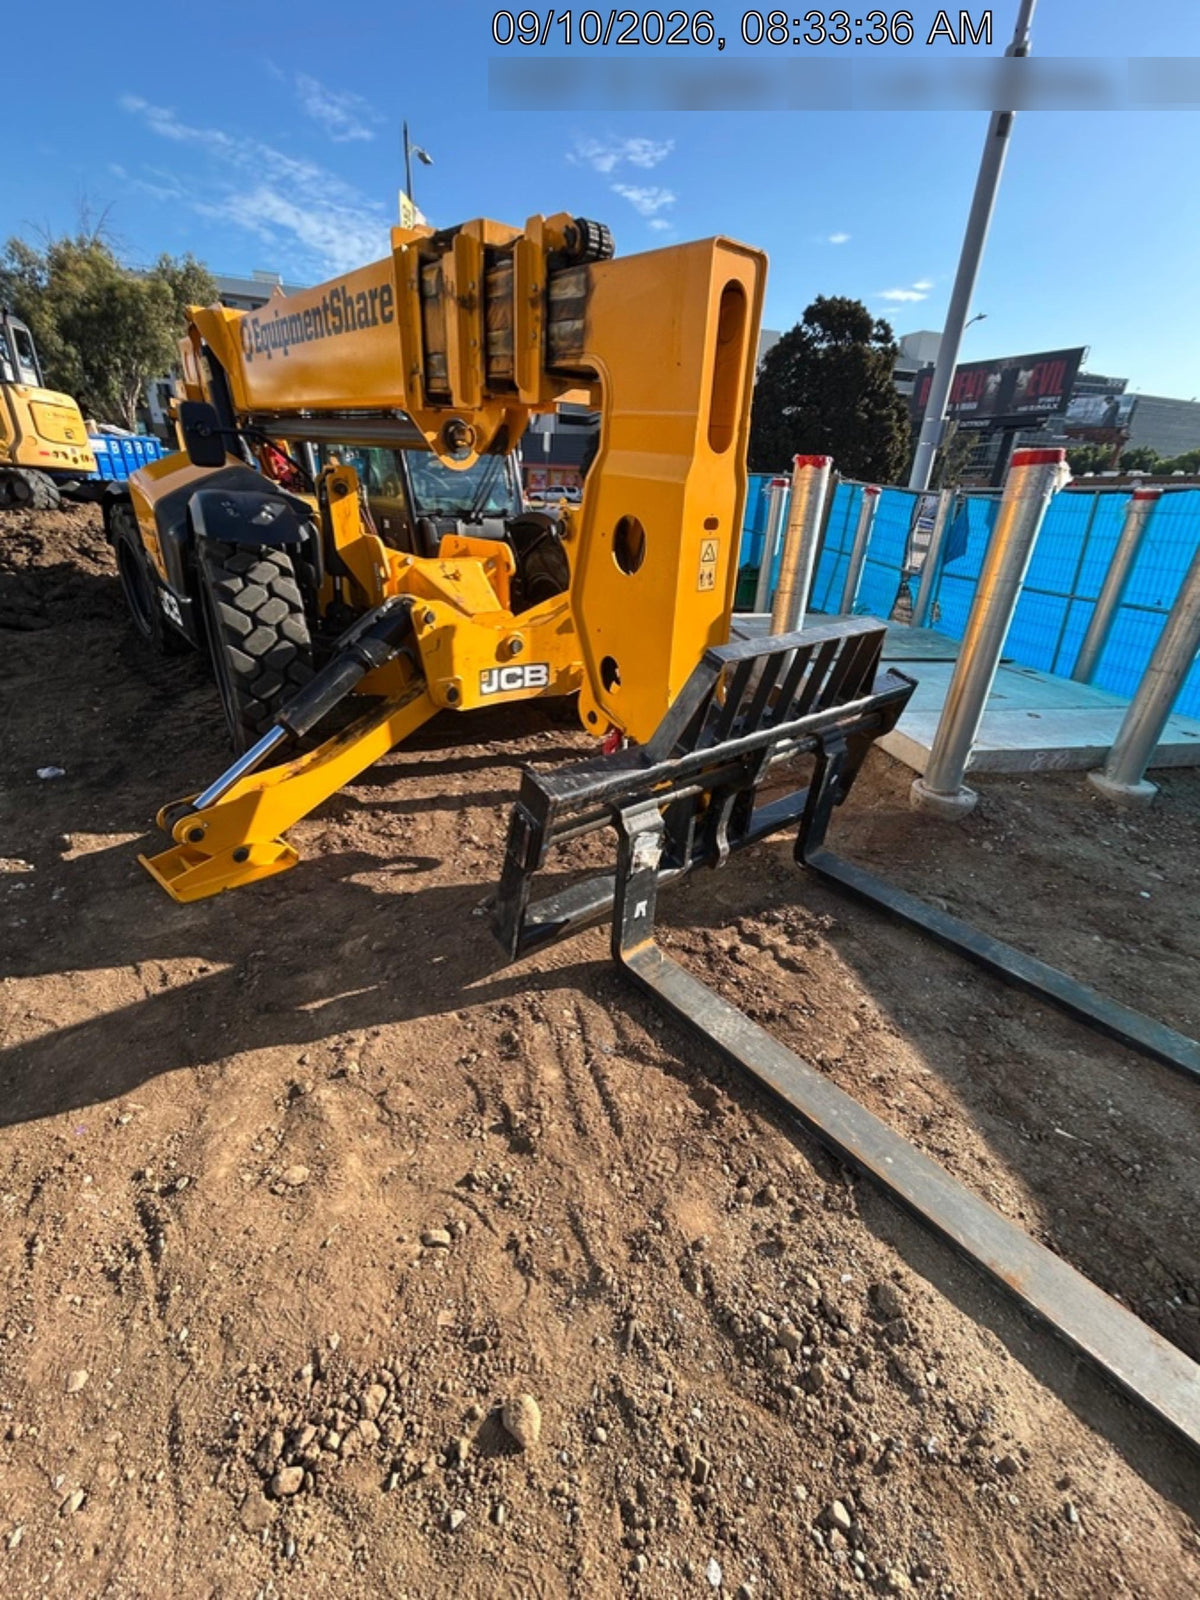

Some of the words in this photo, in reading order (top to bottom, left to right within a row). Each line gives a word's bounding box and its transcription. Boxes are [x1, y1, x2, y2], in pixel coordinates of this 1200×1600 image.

[252, 283, 395, 360] EquipmentShare
[1026, 359, 1068, 397] EVIL
[480, 664, 549, 694] JCB
